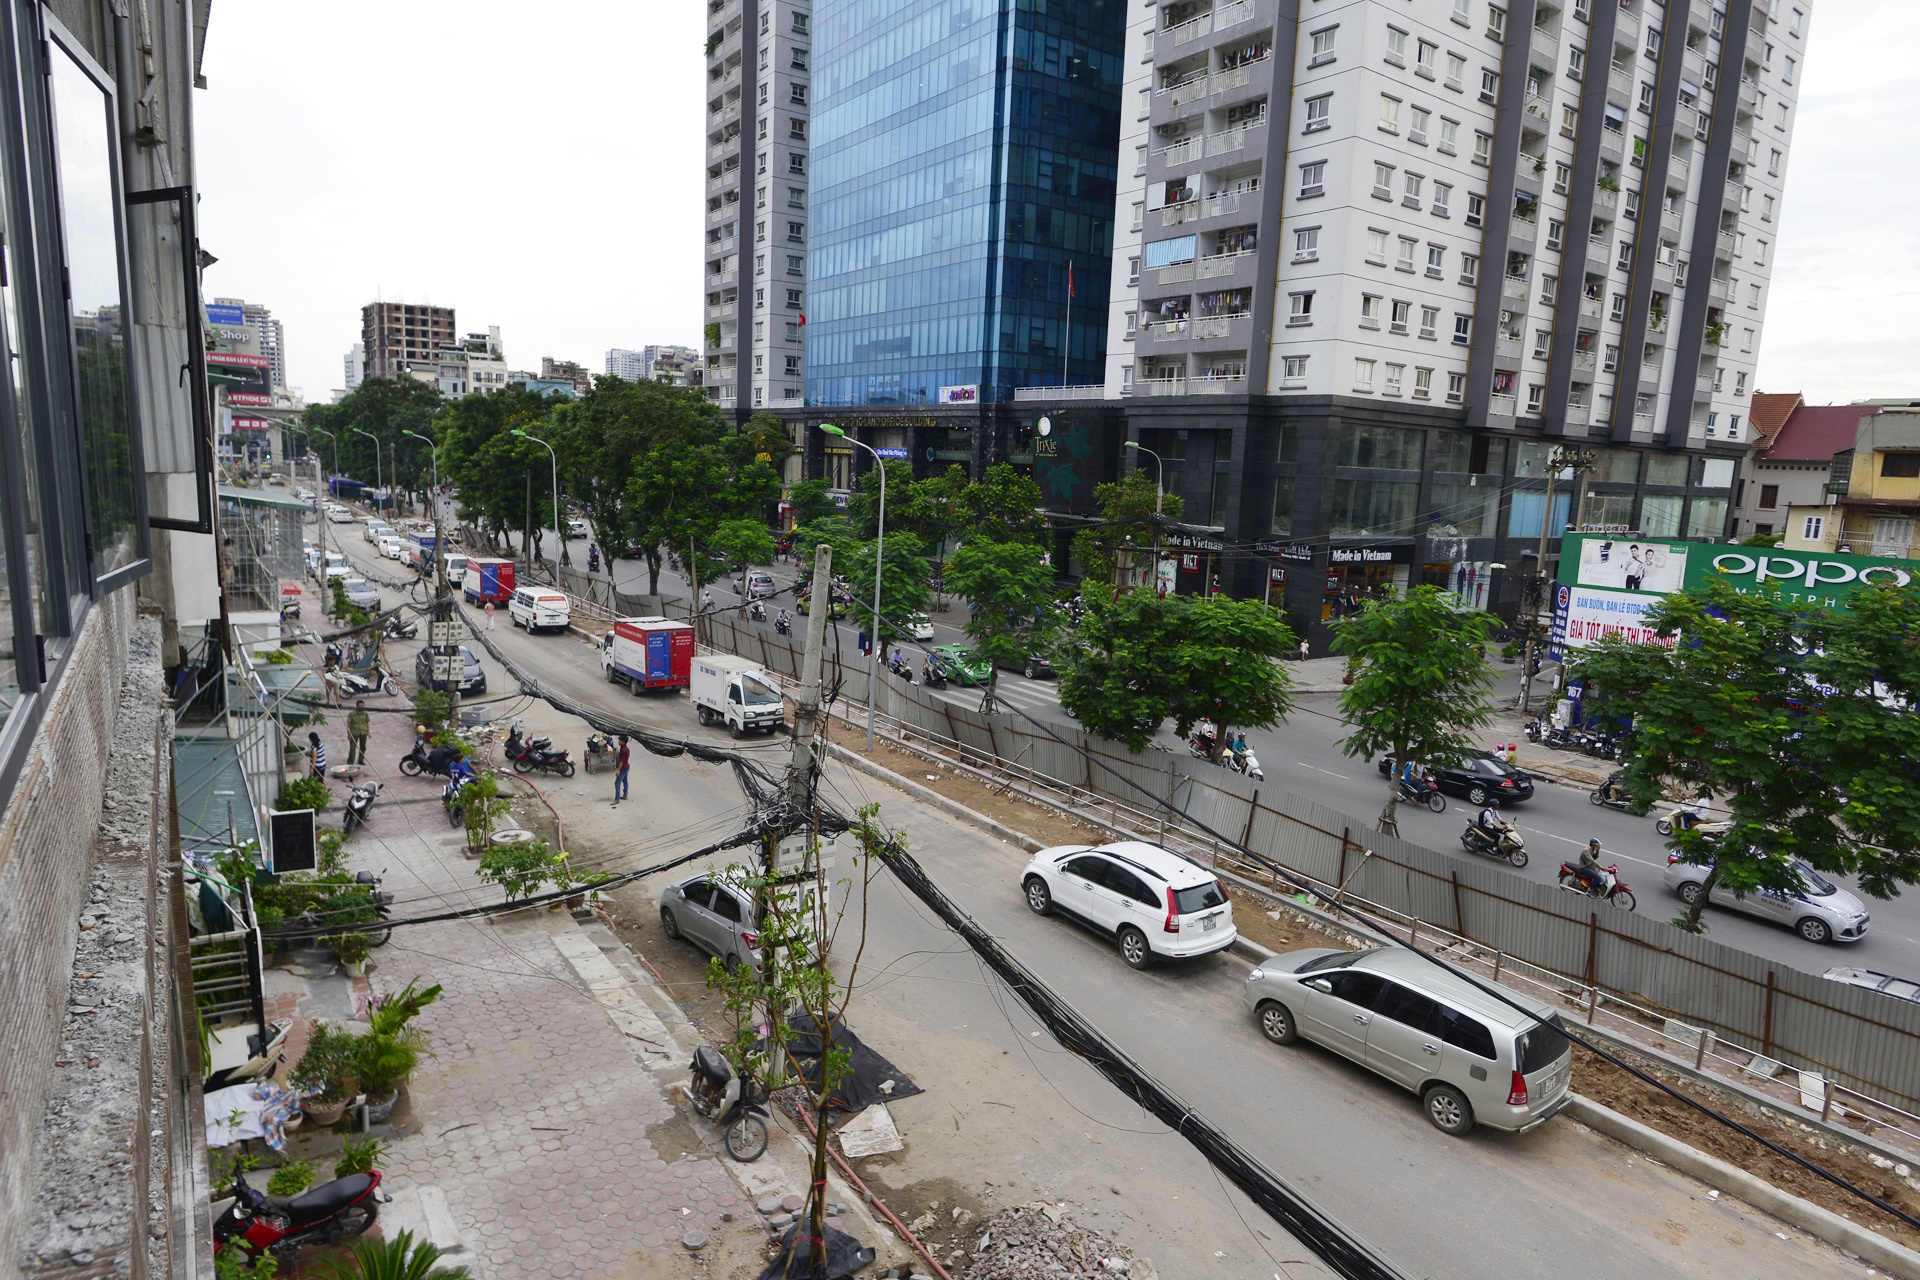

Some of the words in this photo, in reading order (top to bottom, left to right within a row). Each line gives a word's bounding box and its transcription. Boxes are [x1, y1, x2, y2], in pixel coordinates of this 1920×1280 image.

[220, 330, 250, 342] Shop
[1183, 536, 1190, 546] in
[1332, 550, 1353, 561] Made
[1354, 550, 1361, 561] in
[1363, 549, 1391, 561] Vietnam
[1577, 596, 1589, 608] BÁN
[1588, 597, 1605, 612] BUÔN,
[1606, 598, 1618, 611] BÁN
[1570, 617, 1584, 639] GIÁ
[1585, 616, 1601, 641] TỐT
[1566, 686, 1582, 698] 167
